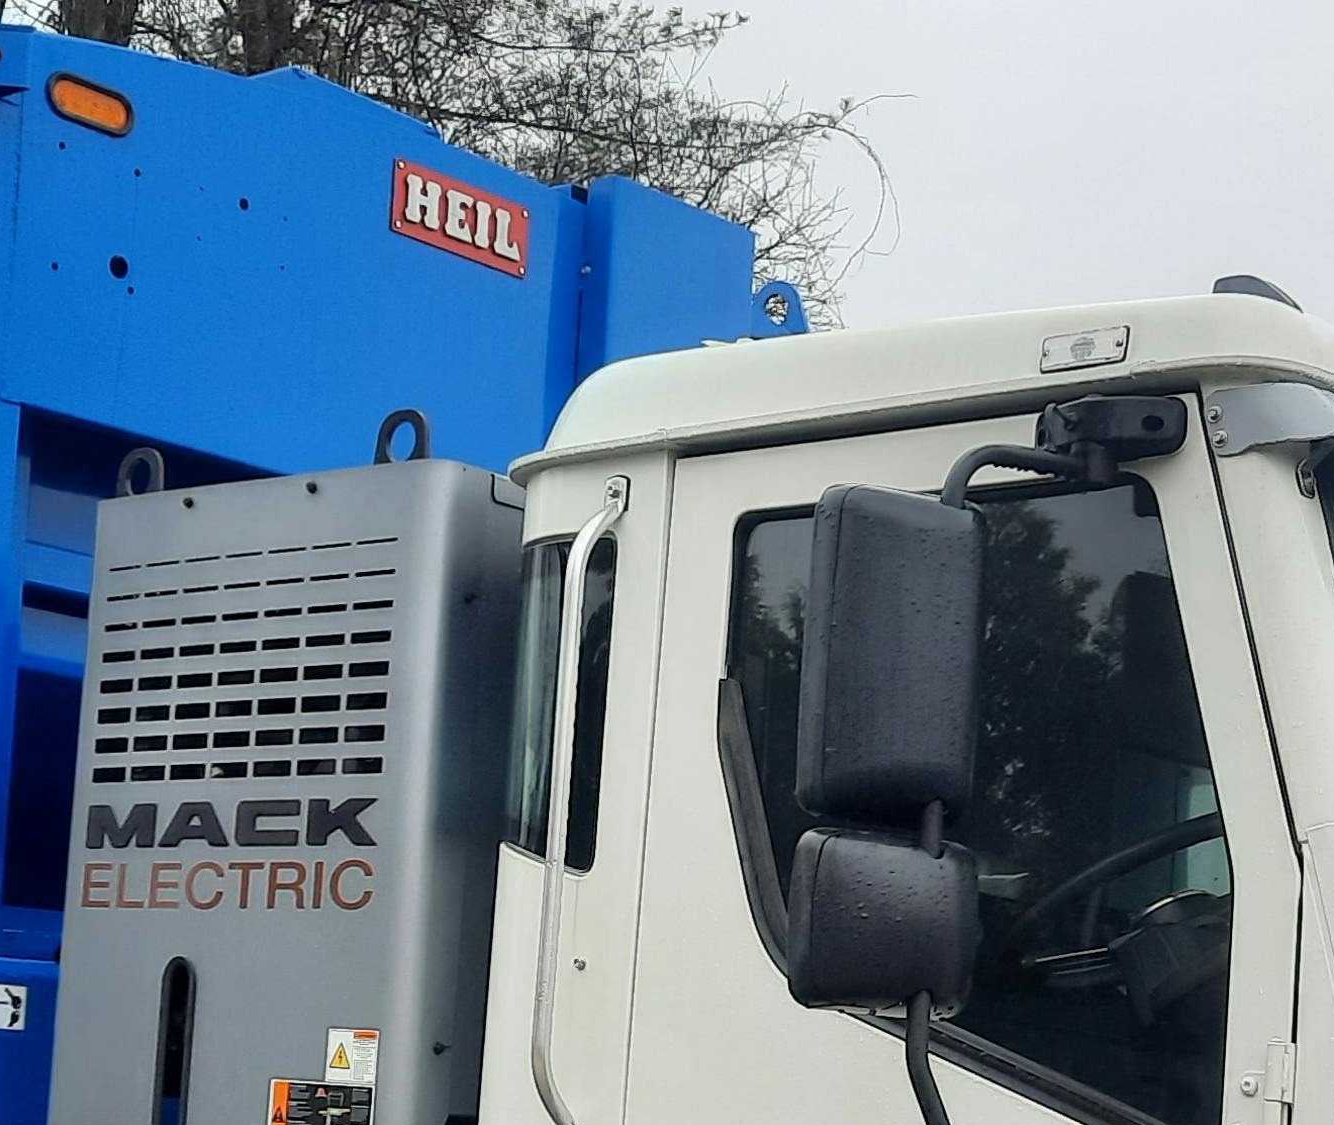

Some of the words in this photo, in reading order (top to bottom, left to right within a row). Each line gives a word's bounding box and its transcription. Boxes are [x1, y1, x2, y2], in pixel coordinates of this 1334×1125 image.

[404, 173, 521, 262] HEIL
[85, 798, 379, 849] MACK
[81, 858, 374, 910] ELECTRIC
